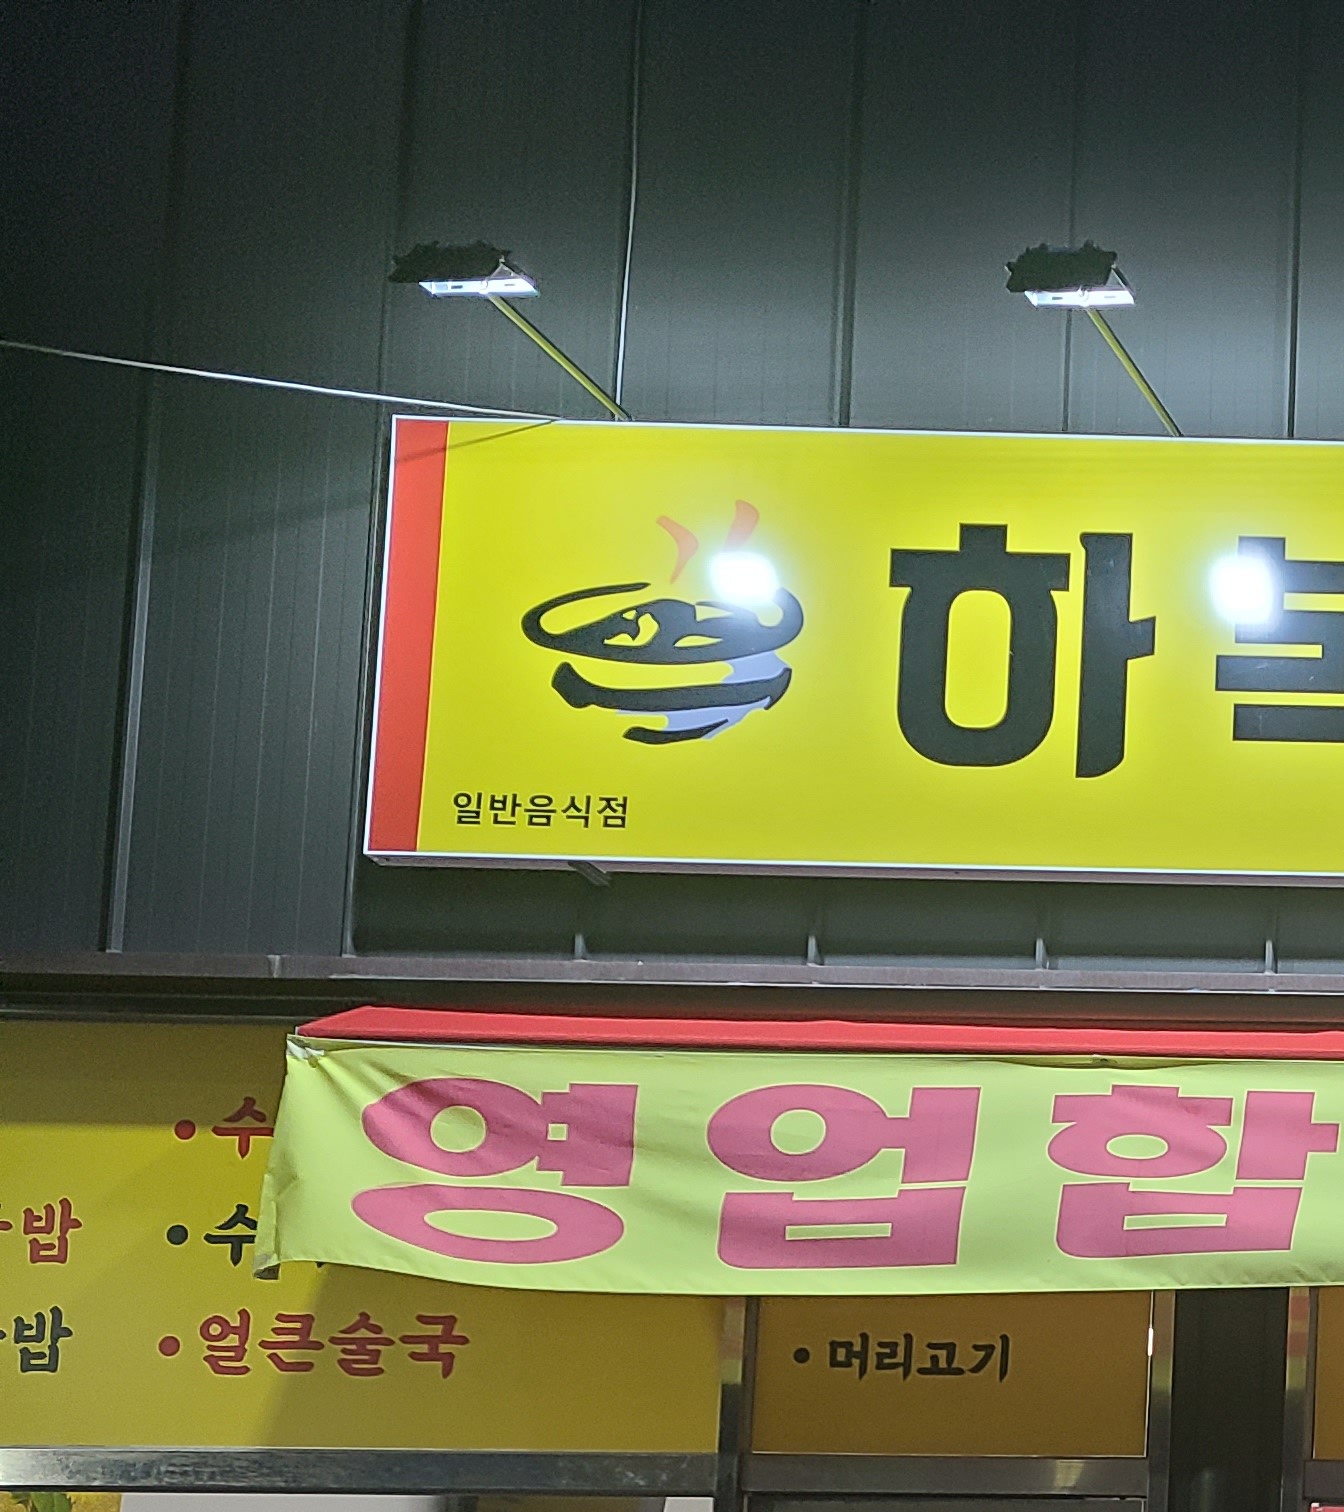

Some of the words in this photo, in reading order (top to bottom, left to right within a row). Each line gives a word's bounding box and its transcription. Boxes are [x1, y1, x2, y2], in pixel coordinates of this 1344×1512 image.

[452, 791, 629, 829] 일반음식점
[199, 1307, 471, 1379] 얼큰술국
[828, 1328, 1014, 1382] 머리고기
